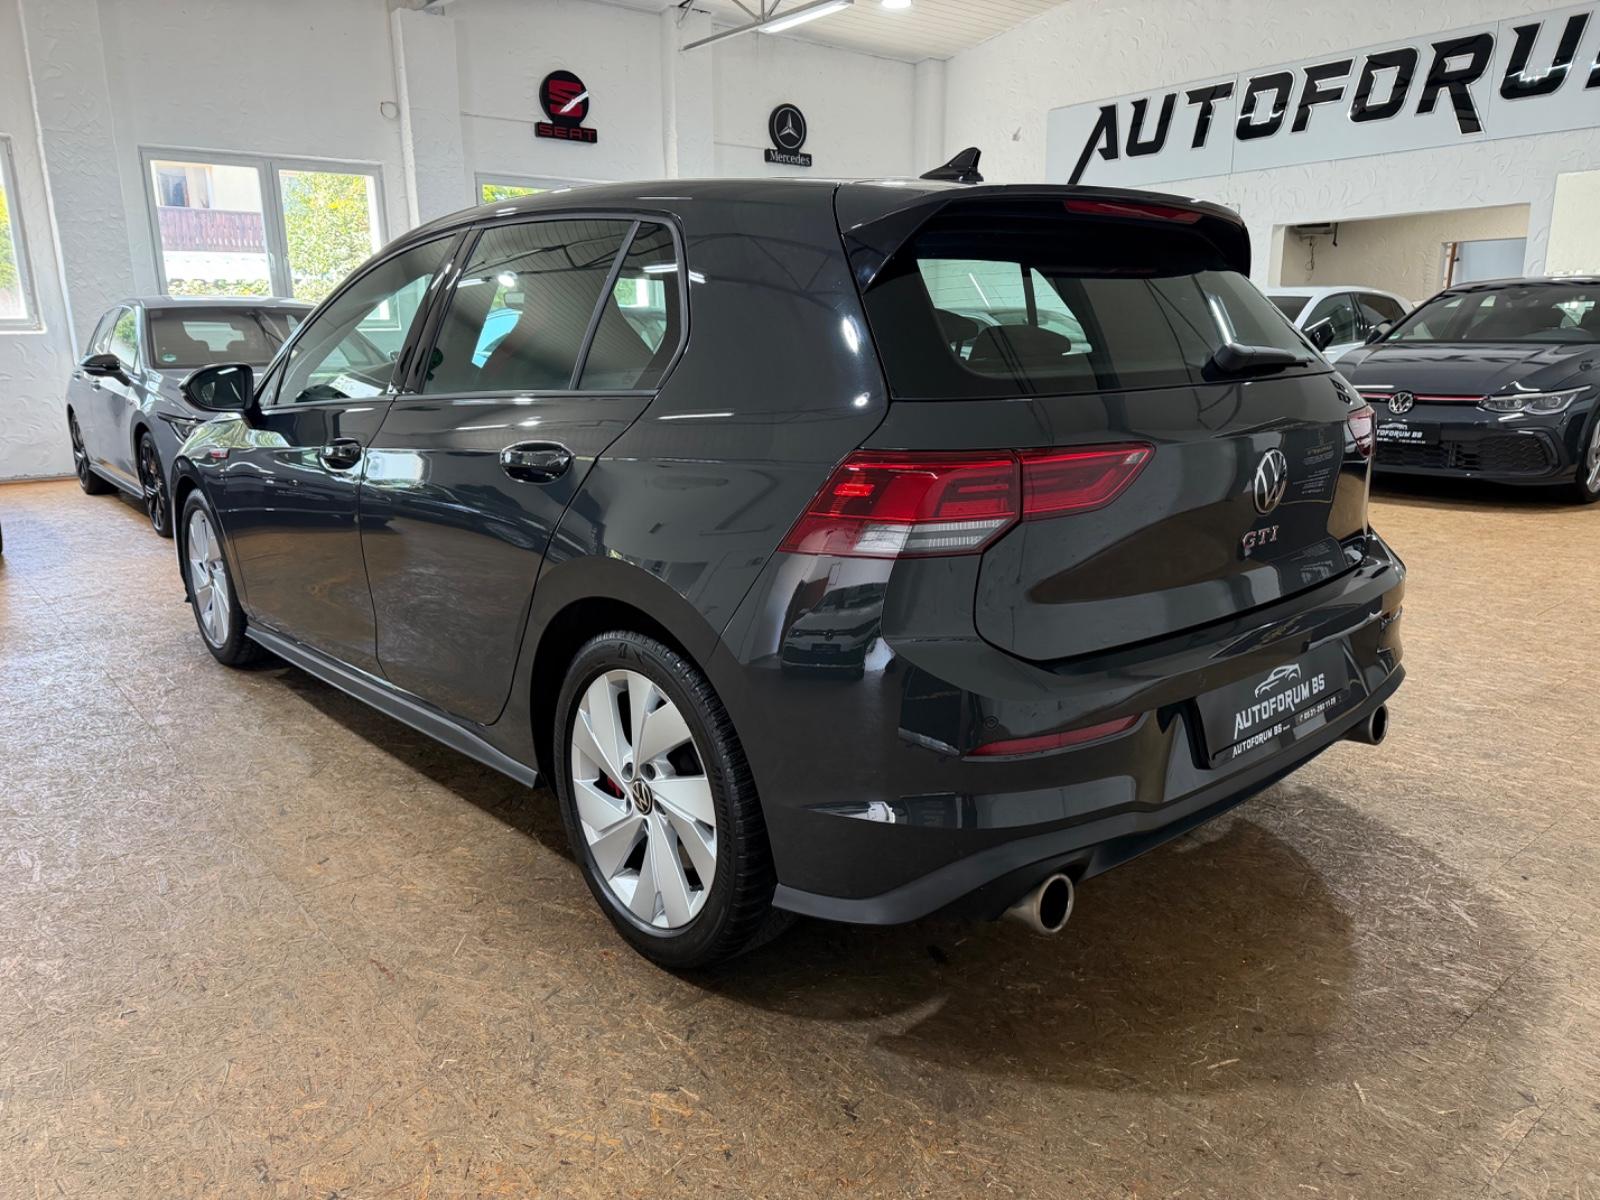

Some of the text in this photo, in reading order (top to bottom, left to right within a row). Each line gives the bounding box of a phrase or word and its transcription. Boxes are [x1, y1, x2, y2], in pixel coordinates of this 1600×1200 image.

[1068, 12, 1600, 184] AUTOFORU
[539, 124, 596, 142] SEAT
[770, 150, 811, 166] Mercedes
[1242, 525, 1279, 549] GTI
[1233, 673, 1325, 740] AUTOFORUM BS
[1232, 729, 1273, 758] AUTOFORUM
